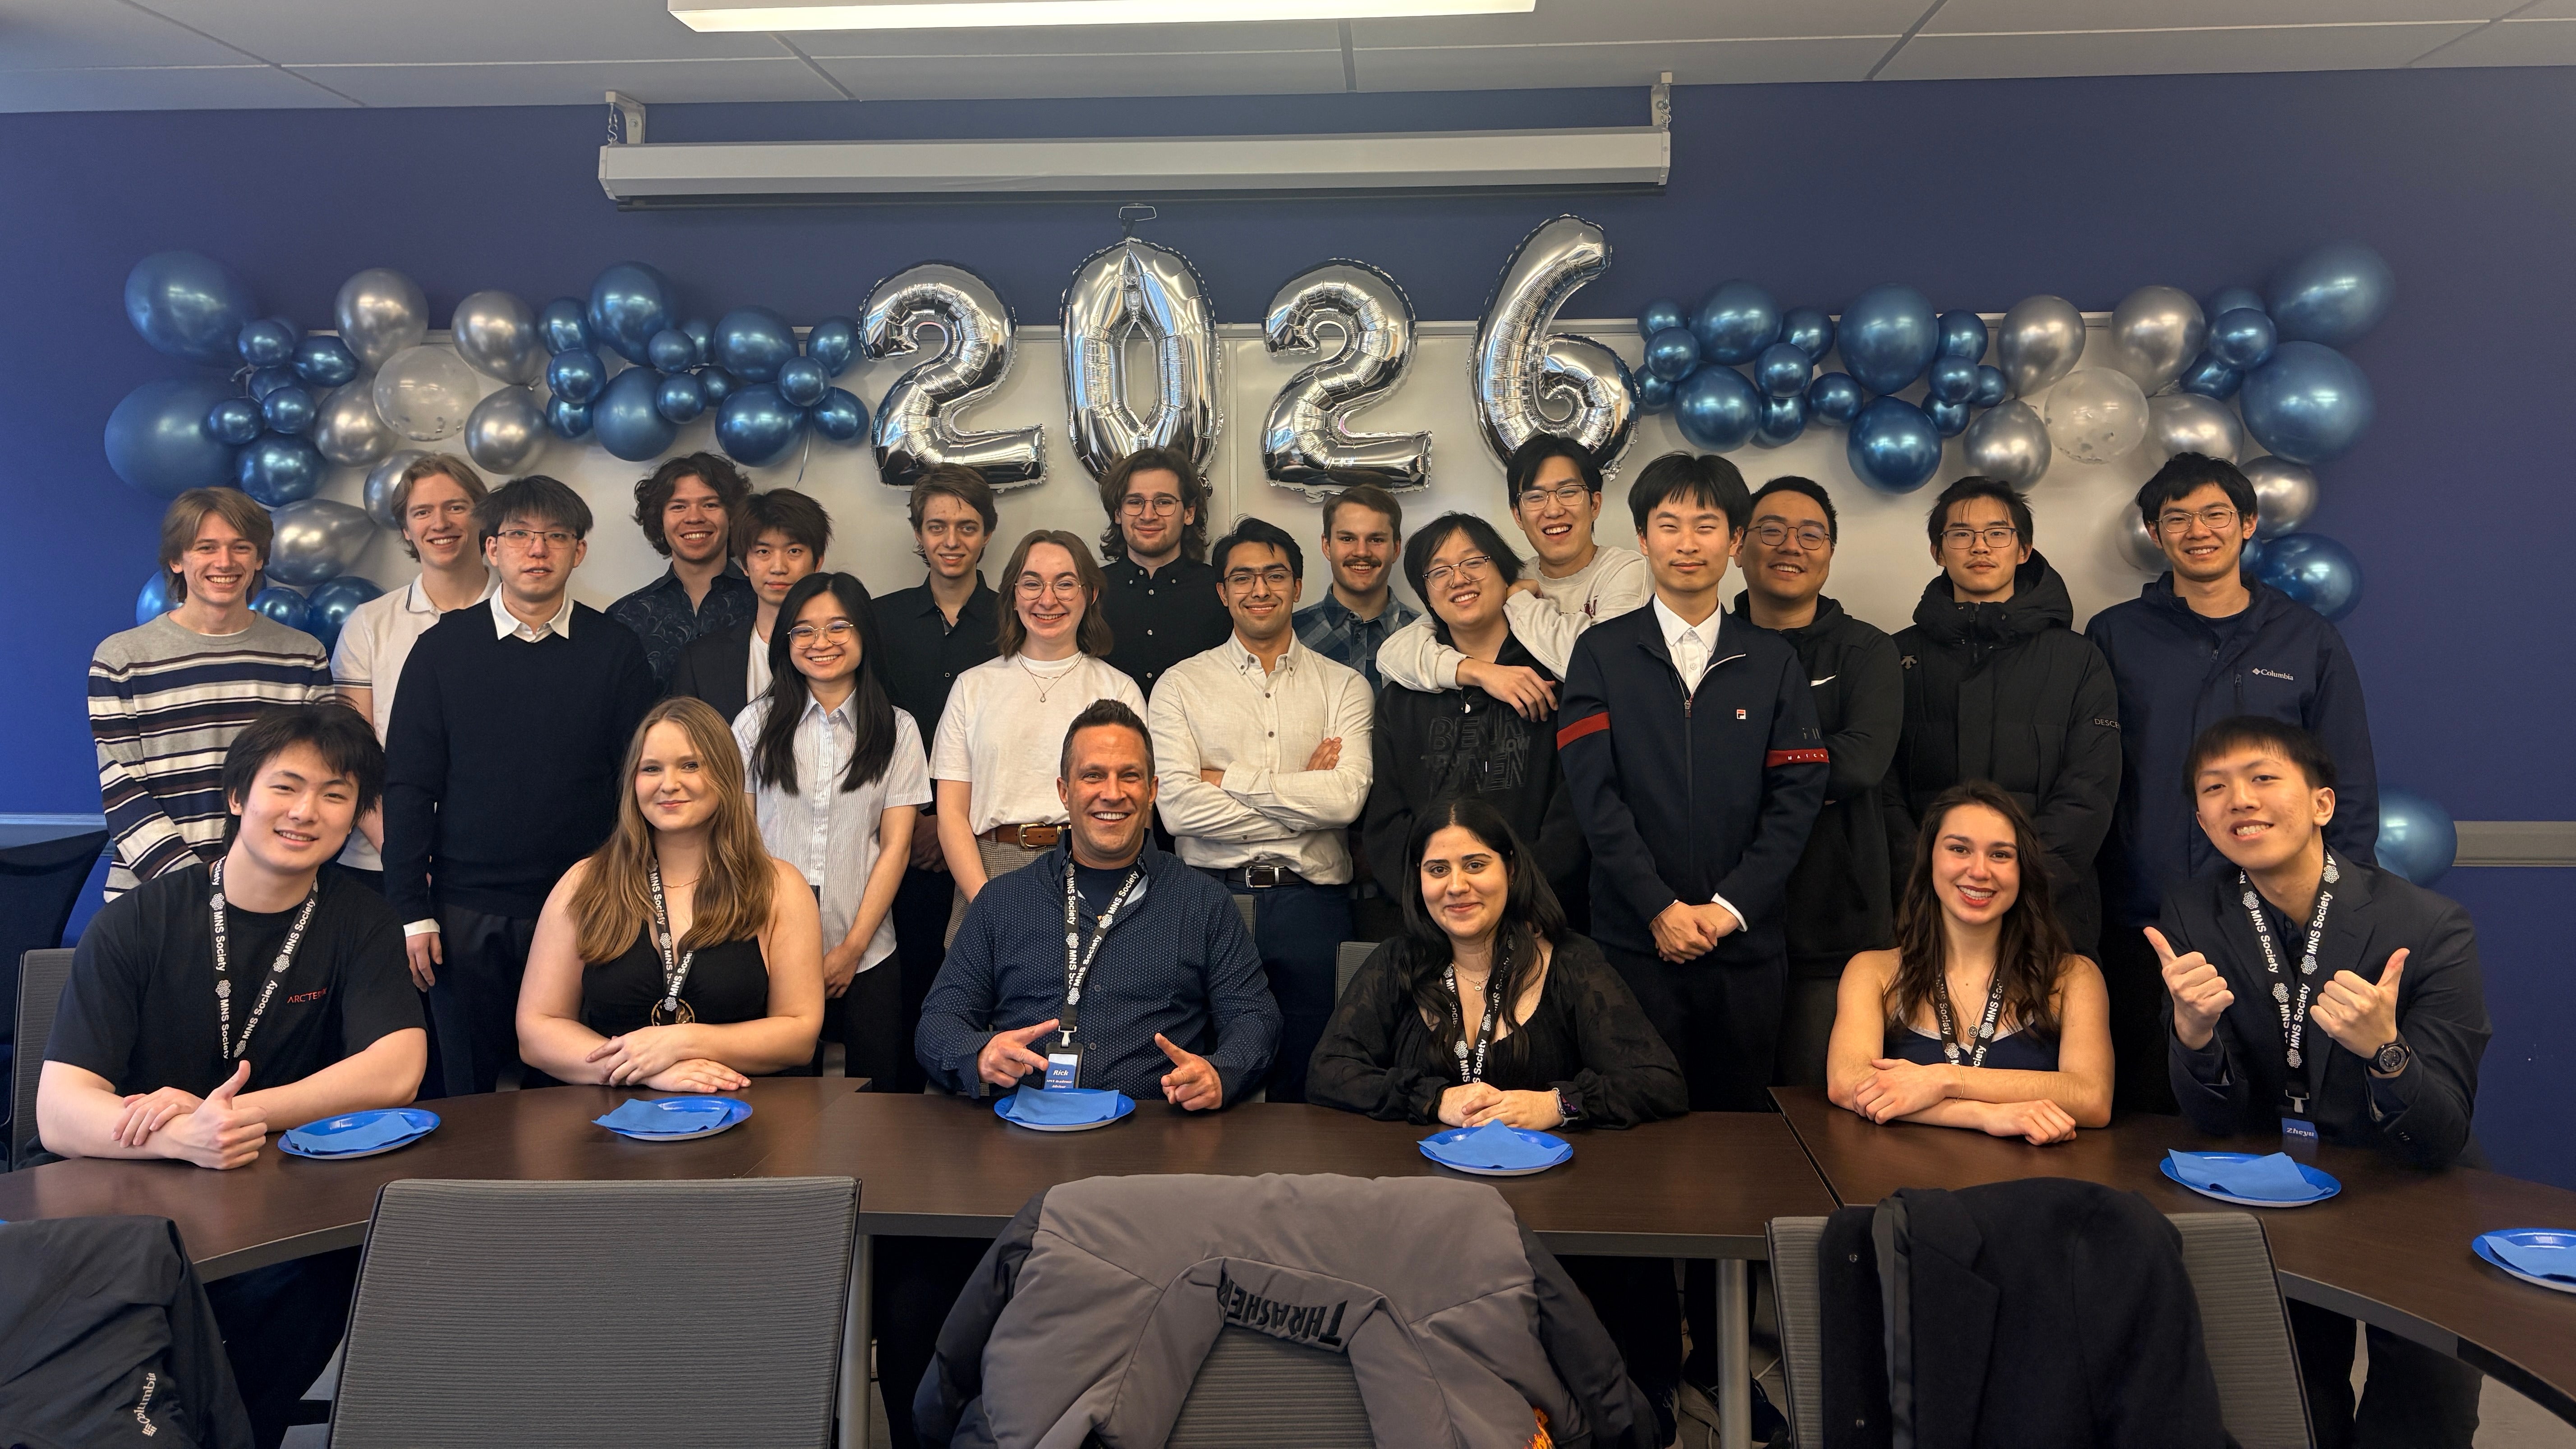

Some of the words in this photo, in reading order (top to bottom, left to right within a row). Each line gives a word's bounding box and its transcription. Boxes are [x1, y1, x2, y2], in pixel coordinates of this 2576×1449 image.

[858, 214, 1641, 495] 2026
[2261, 669, 2294, 681] Columbia
[649, 872, 661, 892] MNS
[1067, 877, 1075, 894] MNS
[1108, 897, 1122, 914] MNS
[1118, 871, 1139, 897] Society
[213, 911, 224, 933] MNS
[653, 893, 666, 925] Society
[1067, 895, 1076, 925] Society
[2313, 891, 2333, 929] Society
[283, 932, 300, 955] MNS
[294, 898, 316, 931] Society
[216, 936, 225, 971] Society
[2250, 910, 2267, 933] MNS
[2261, 934, 2279, 974] Society
[2306, 929, 2321, 955] MNS
[664, 950, 673, 971] MNS
[1069, 949, 1077, 971] MNS
[1073, 966, 1086, 986] MNS
[1083, 935, 1102, 965] Society
[668, 975, 683, 996] MNS
[220, 998, 230, 1022] MNS
[242, 1017, 258, 1039] MNS
[254, 980, 278, 1016] Society
[1986, 1001, 1999, 1022] MNS
[2294, 983, 2311, 1022] Society
[221, 1023, 230, 1059] Society
[2290, 1021, 2301, 1049] MNS
[1973, 1045, 1987, 1067] ciety
[1460, 1059, 1470, 1082] MNS
